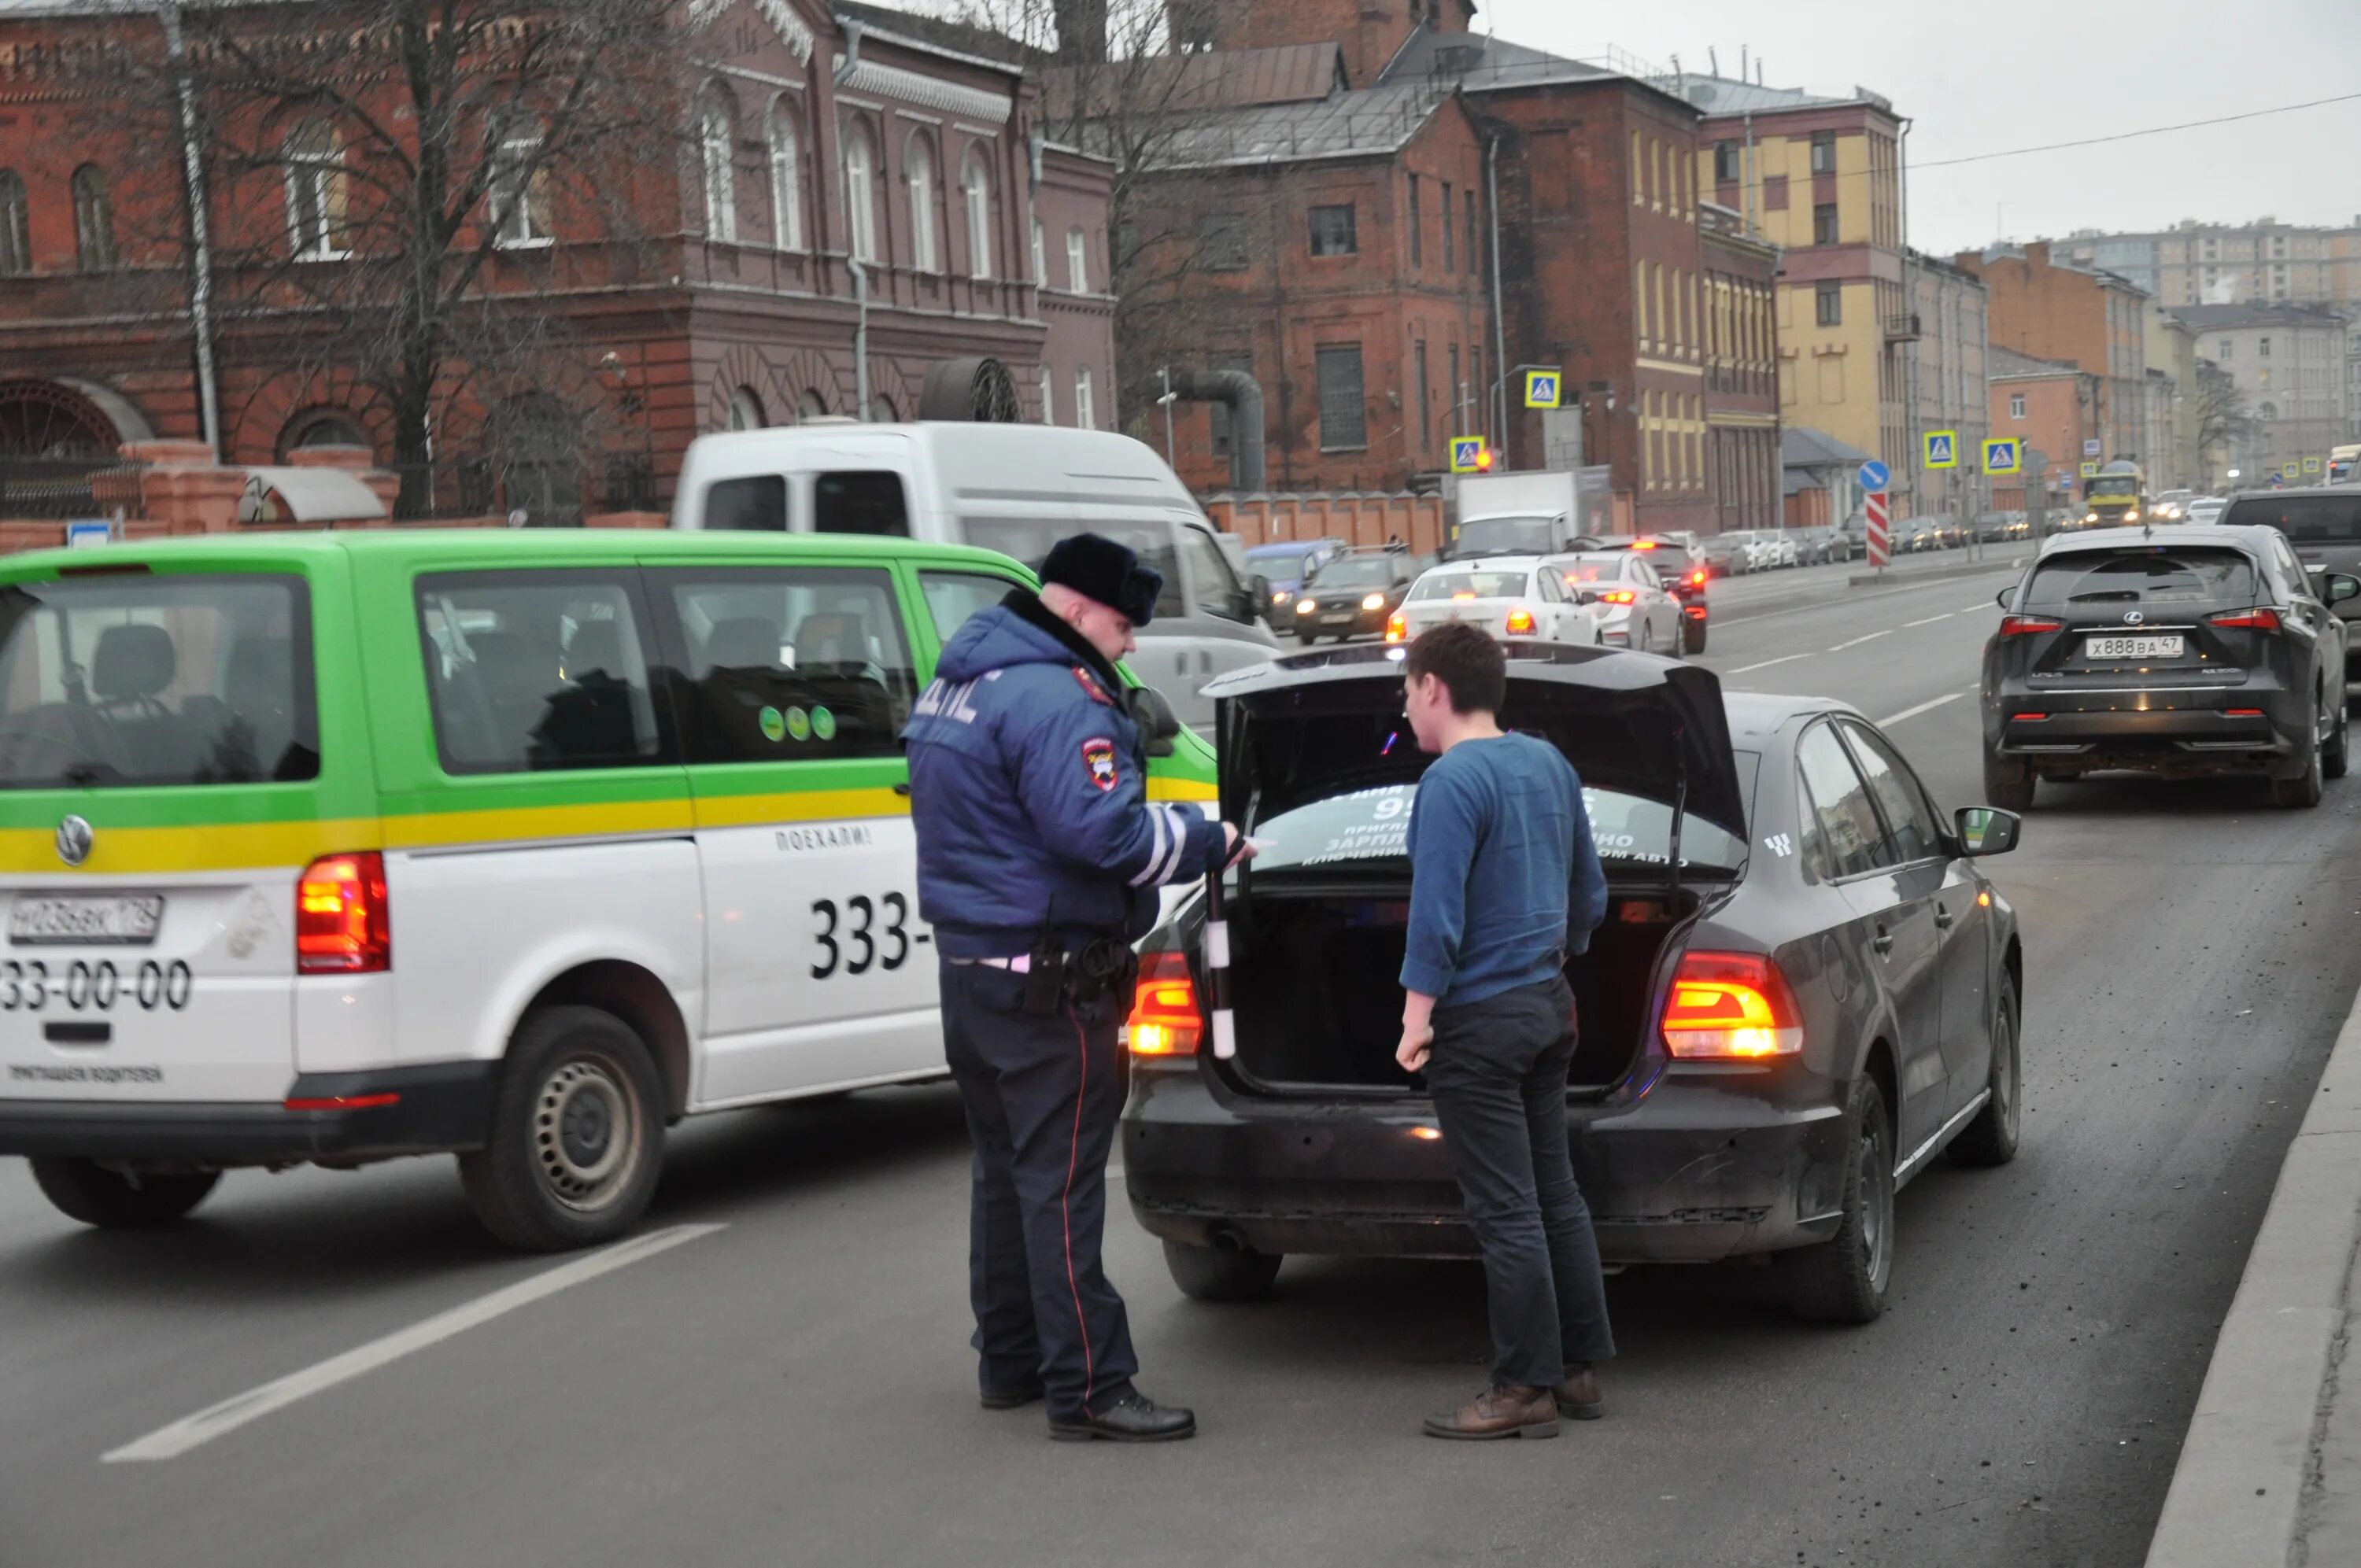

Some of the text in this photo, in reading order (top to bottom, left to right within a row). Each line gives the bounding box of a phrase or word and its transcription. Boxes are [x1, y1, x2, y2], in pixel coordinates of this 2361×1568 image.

[2161, 636, 2178, 649] 47
[774, 825, 872, 851] ПОЕХАЛИ!
[0, 959, 192, 1010] 33-00-00
